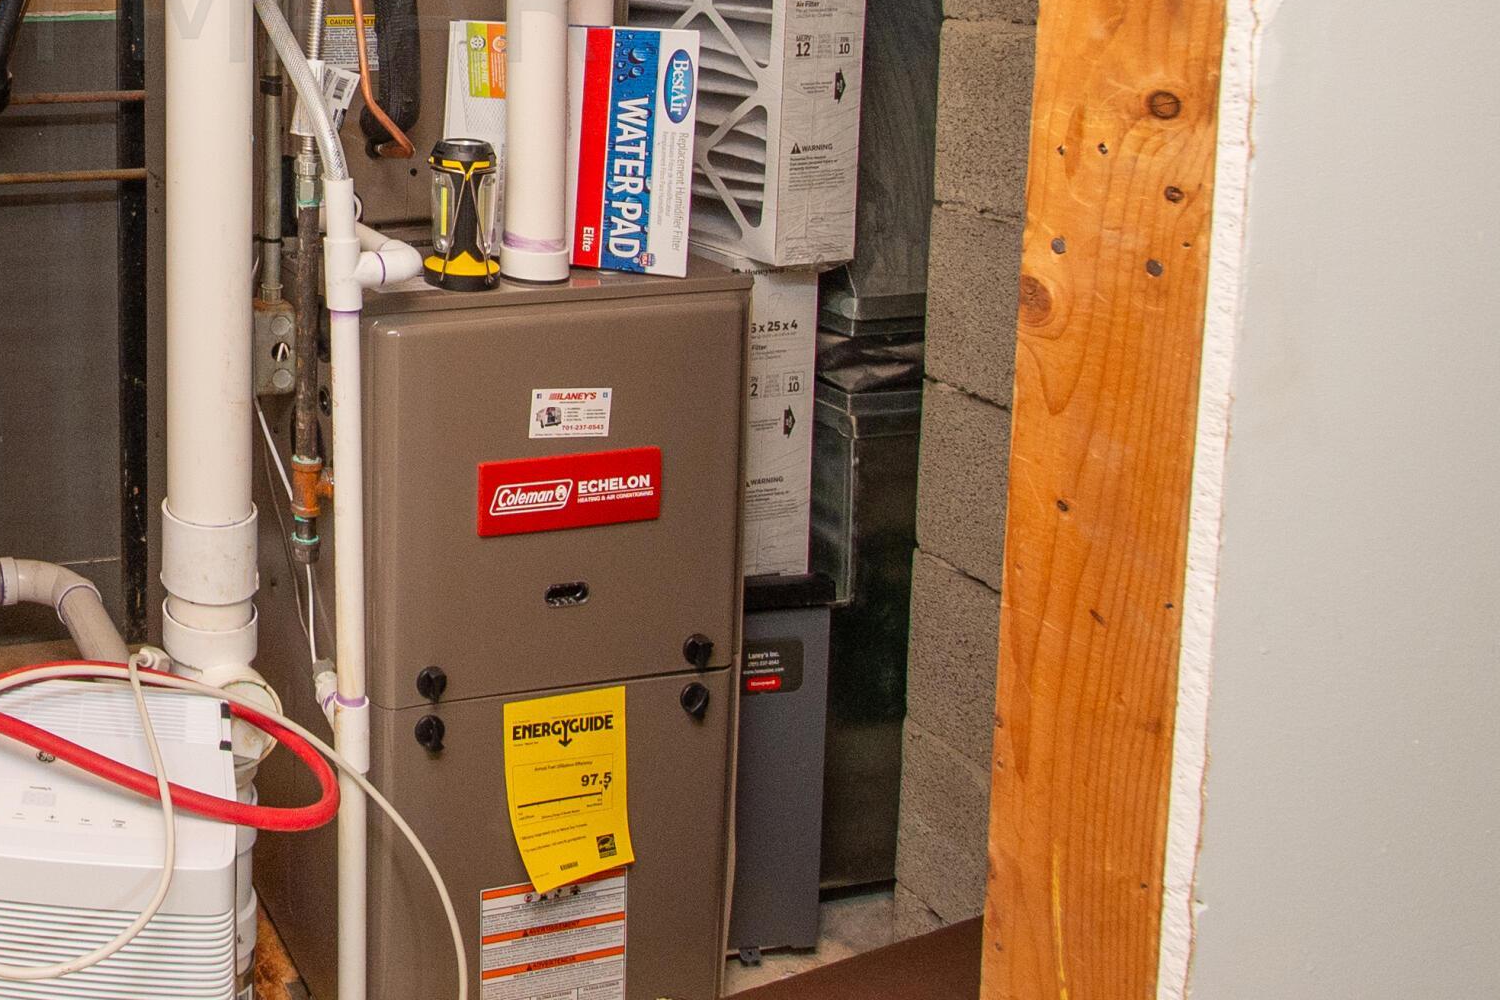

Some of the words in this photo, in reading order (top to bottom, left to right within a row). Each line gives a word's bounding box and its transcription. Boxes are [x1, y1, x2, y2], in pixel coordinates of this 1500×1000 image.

[805, 0, 820, 8] Filter
[795, 42, 811, 57] 12
[838, 43, 850, 55] 10
[612, 96, 649, 194] WATER
[801, 143, 833, 153] WARNING
[675, 132, 689, 185] Replacement
[673, 187, 686, 229] Humidifier
[608, 200, 643, 258] PAD
[581, 226, 595, 252] Elite
[671, 230, 683, 251] Filter
[758, 324, 765, 333] x
[767, 321, 781, 332] 25
[782, 322, 789, 331] x
[790, 320, 798, 330] 4
[750, 383, 758, 397] 2
[787, 381, 800, 393] 10
[559, 392, 597, 400] LANEY'S
[577, 474, 651, 494] ECHELON
[750, 476, 784, 486] WARNING
[497, 488, 555, 507] Coleman
[577, 496, 601, 504] HEATING
[616, 490, 654, 500] CONDITIONING
[512, 714, 613, 747] ENERGYGUIDE
[581, 772, 612, 787] 97.5
